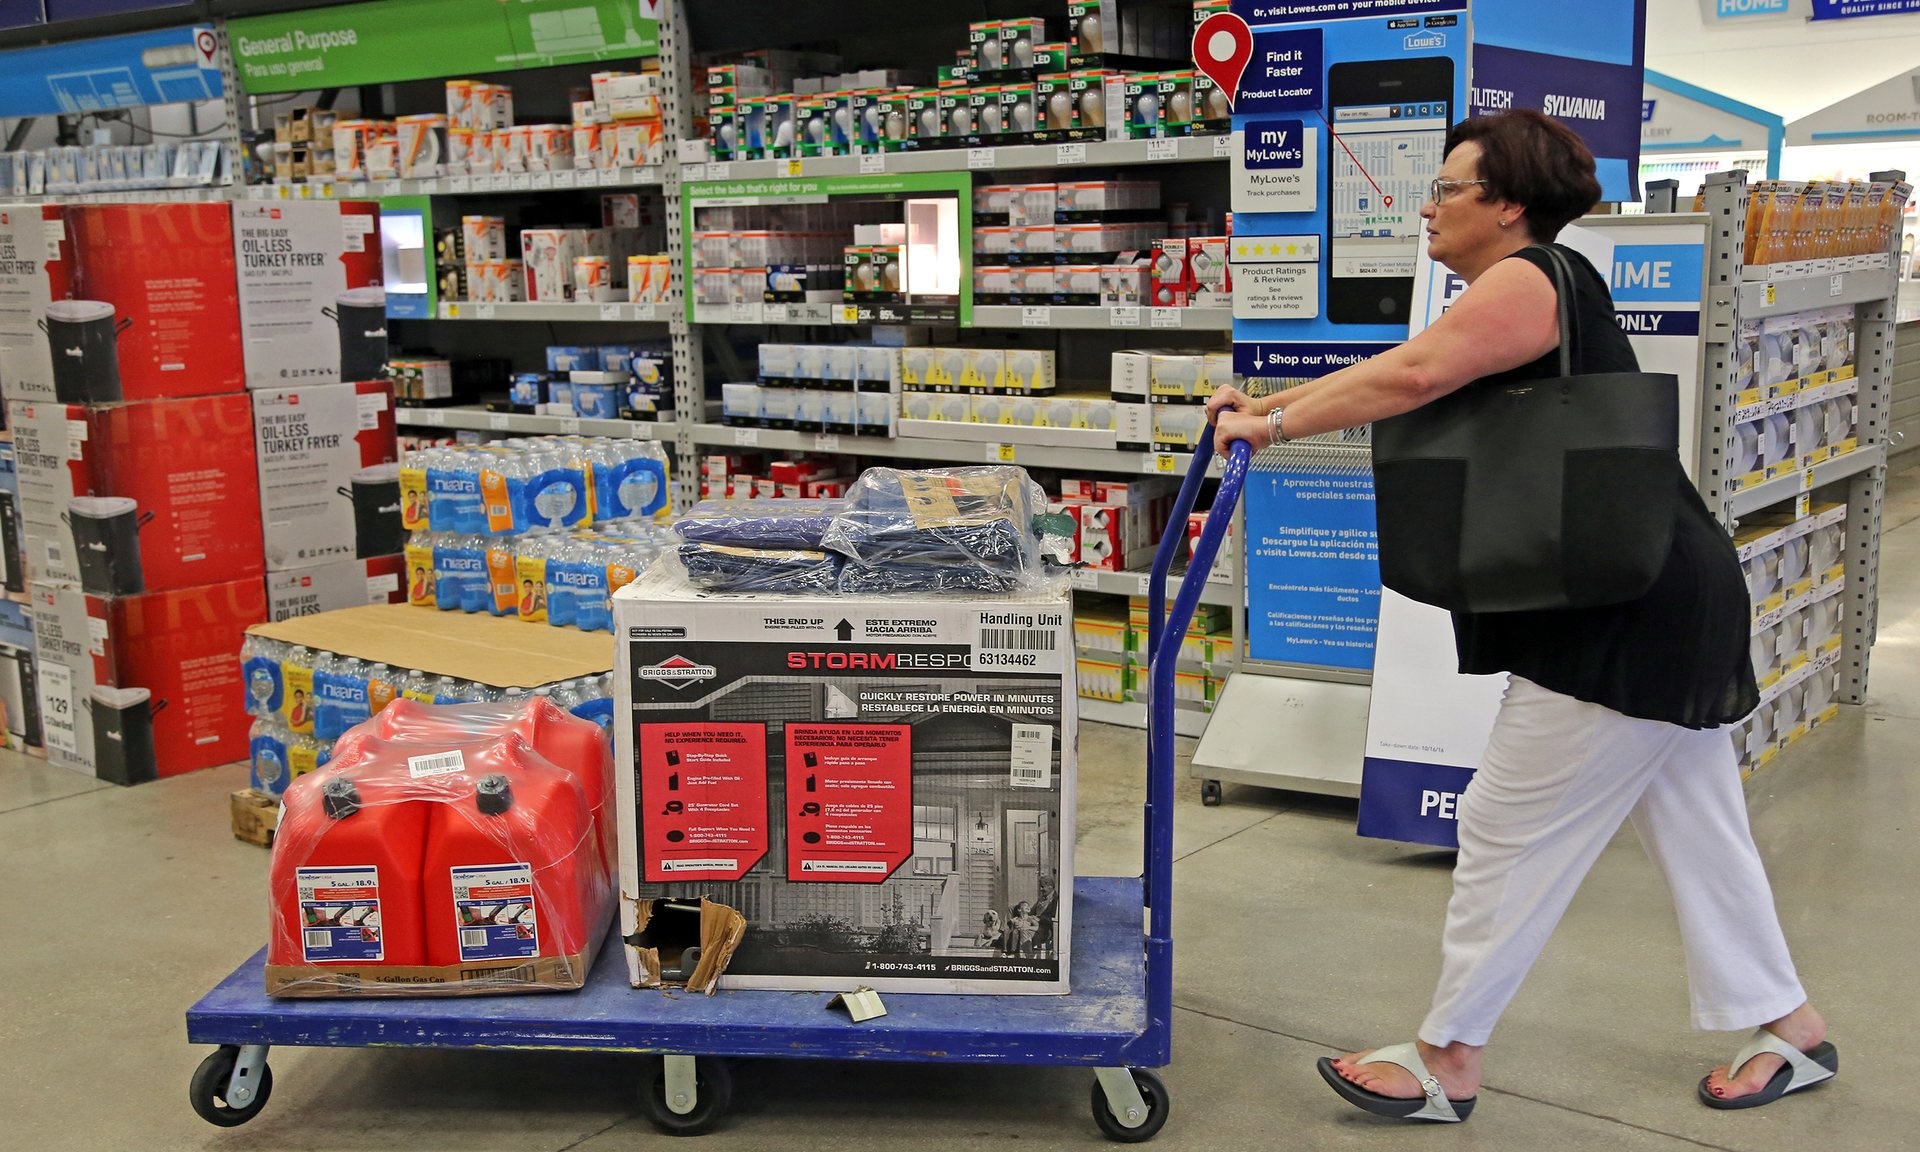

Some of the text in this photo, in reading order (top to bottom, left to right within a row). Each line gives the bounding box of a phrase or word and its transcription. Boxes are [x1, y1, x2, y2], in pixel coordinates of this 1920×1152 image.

[1069, 6, 1086, 17] LED
[1254, 9, 1267, 17] Or,
[1268, 7, 1287, 16] visit
[1288, 3, 1336, 14] Lowes.com
[1352, 1, 1373, 11] your
[1841, 2, 1902, 15] QUALITY SINCE
[970, 32, 986, 42] LED
[1002, 29, 1017, 40] LED
[238, 29, 358, 57] General Purpose
[1033, 54, 1051, 65] LED
[1266, 50, 1303, 63] Find it
[245, 56, 324, 77] Para uso general
[1266, 66, 1303, 77] Faster
[1125, 84, 1142, 94] LED
[1158, 81, 1175, 92] LED
[1195, 78, 1212, 89] LED
[1001, 94, 1017, 104] LED
[1242, 87, 1312, 99] Product Locator
[1543, 94, 1606, 120] SYLVANIA
[1867, 112, 1920, 124] ROOM-T
[1260, 130, 1287, 147] my
[1247, 148, 1301, 163] MyLowe's
[1250, 174, 1301, 185] MyLowe's
[689, 186, 715, 197] Select
[716, 185, 727, 195] the
[728, 185, 745, 195] bulb
[746, 185, 768, 194] that's
[769, 183, 788, 194] right
[789, 183, 800, 192] for
[801, 183, 818, 193] you
[1266, 190, 1301, 198] purchases
[242, 229, 288, 238] THE BIG EASY
[242, 239, 293, 253] OIL-LESS
[244, 253, 325, 268] TURKEY FRYER
[1242, 266, 1307, 276] Product Ratings
[1614, 261, 1672, 289] IME
[1253, 275, 1295, 284] & Reviews
[1247, 294, 1269, 303] ratings
[1283, 302, 1300, 311] shop
[1615, 313, 1663, 331] ONLY
[1268, 353, 1366, 367] Shop our Weekly
[262, 424, 310, 439] OIL-LESS
[263, 435, 340, 454] TURKEY FRYER
[1283, 478, 1373, 490] Aproveche nuestras
[1296, 490, 1344, 501] especiales
[1279, 526, 1368, 539] Simplifique y agilice
[1262, 537, 1364, 550] Descargue la aplicación
[1263, 549, 1287, 557] visite
[1288, 550, 1337, 559] Lowes.com
[1339, 551, 1366, 560] desde
[1367, 552, 1378, 560] su
[1269, 583, 1359, 595] Encuéntrelo más fácilmente
[980, 612, 1063, 628] Handling Unit
[979, 653, 1036, 666] 63134462
[860, 692, 1054, 704] QUICKLY RESTORE POWER IN MINUTES
[861, 702, 1054, 715] RESTABLECE LA ENERGÍA EN MINUTOS
[872, 962, 1051, 974] 1-800-743-4115 BRIGGSandSTRATTON.com
[375, 976, 445, 984] 5-Gallon Gas Can
